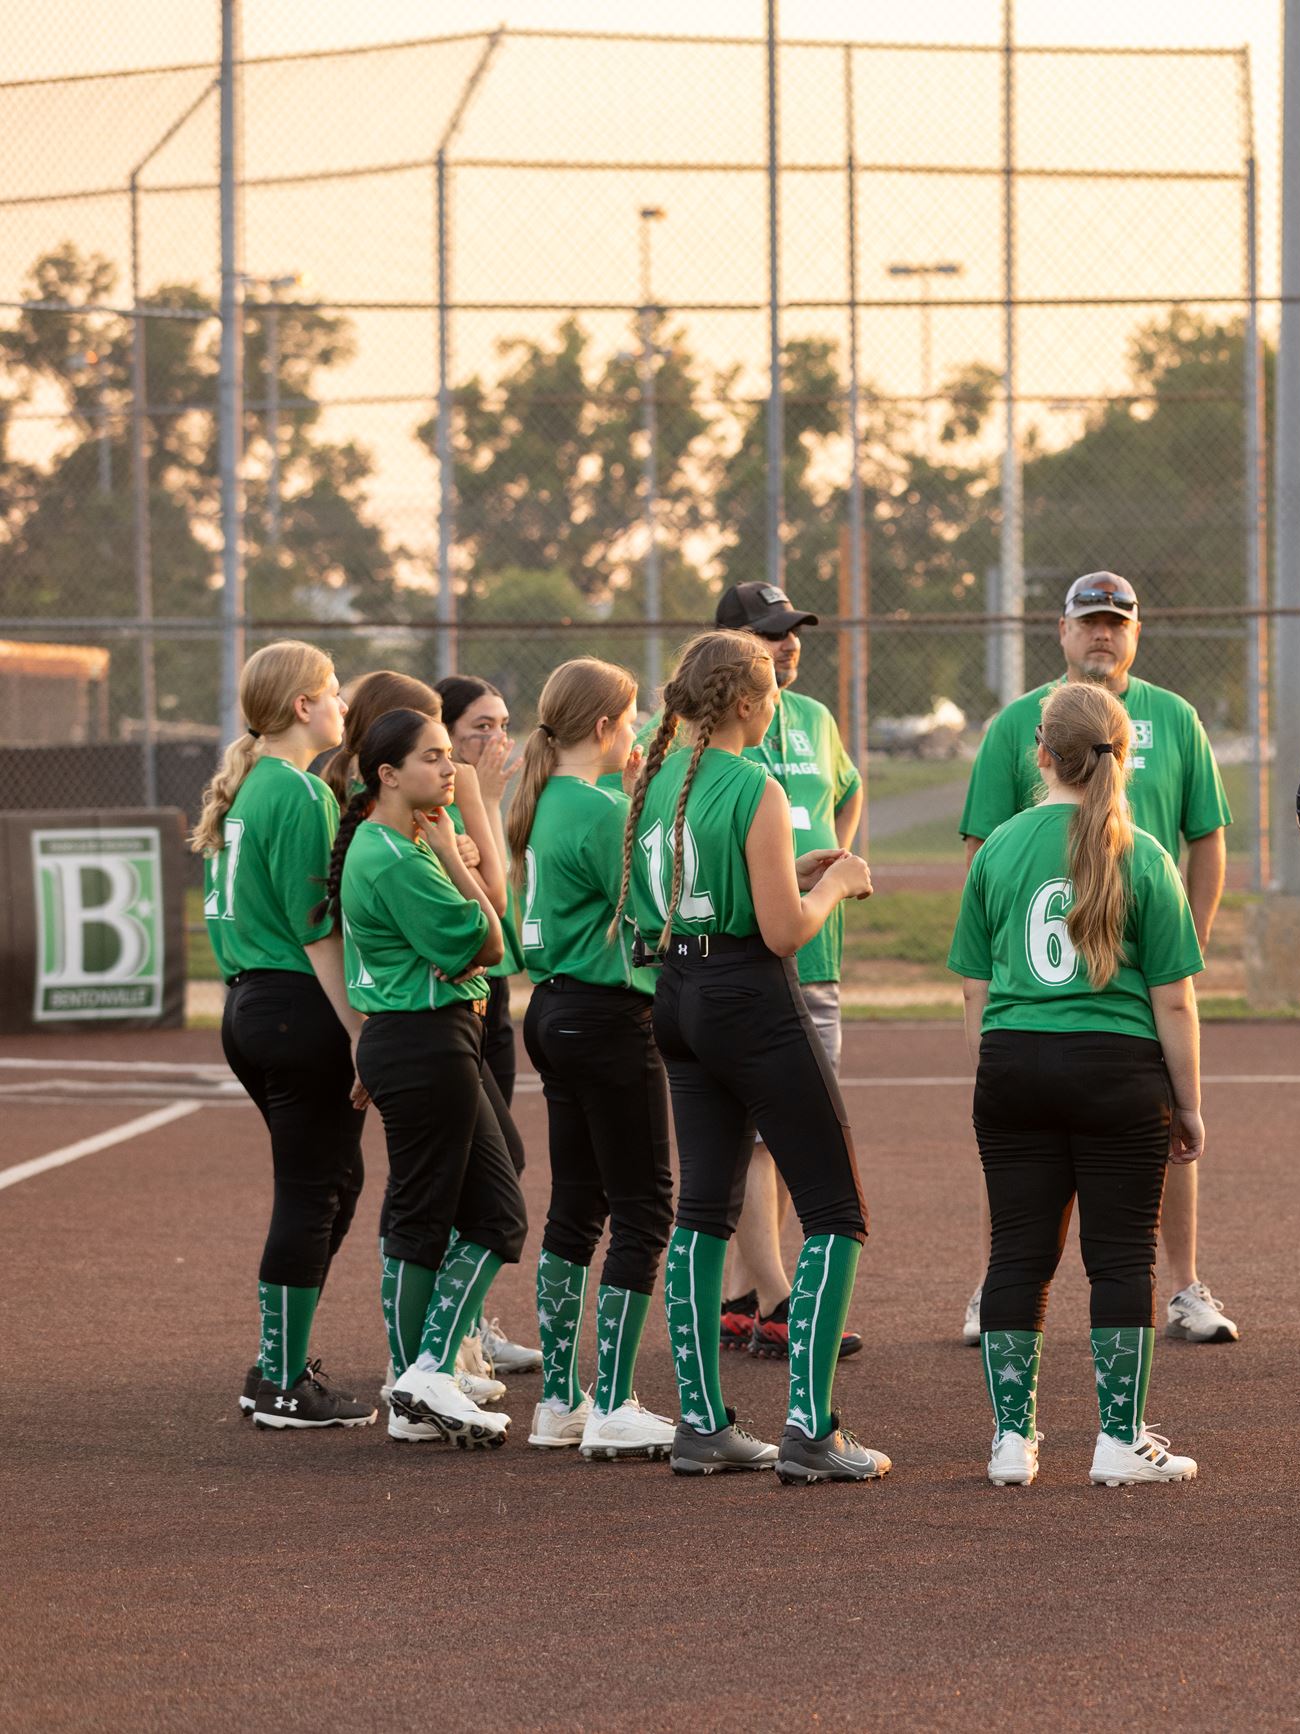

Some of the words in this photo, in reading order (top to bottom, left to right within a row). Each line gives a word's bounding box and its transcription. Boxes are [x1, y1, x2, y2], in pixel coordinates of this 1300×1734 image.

[54, 857, 149, 979] B
[638, 815, 717, 924] 12
[1025, 877, 1079, 987] 6
[51, 987, 146, 1009] BENTONVILLE
